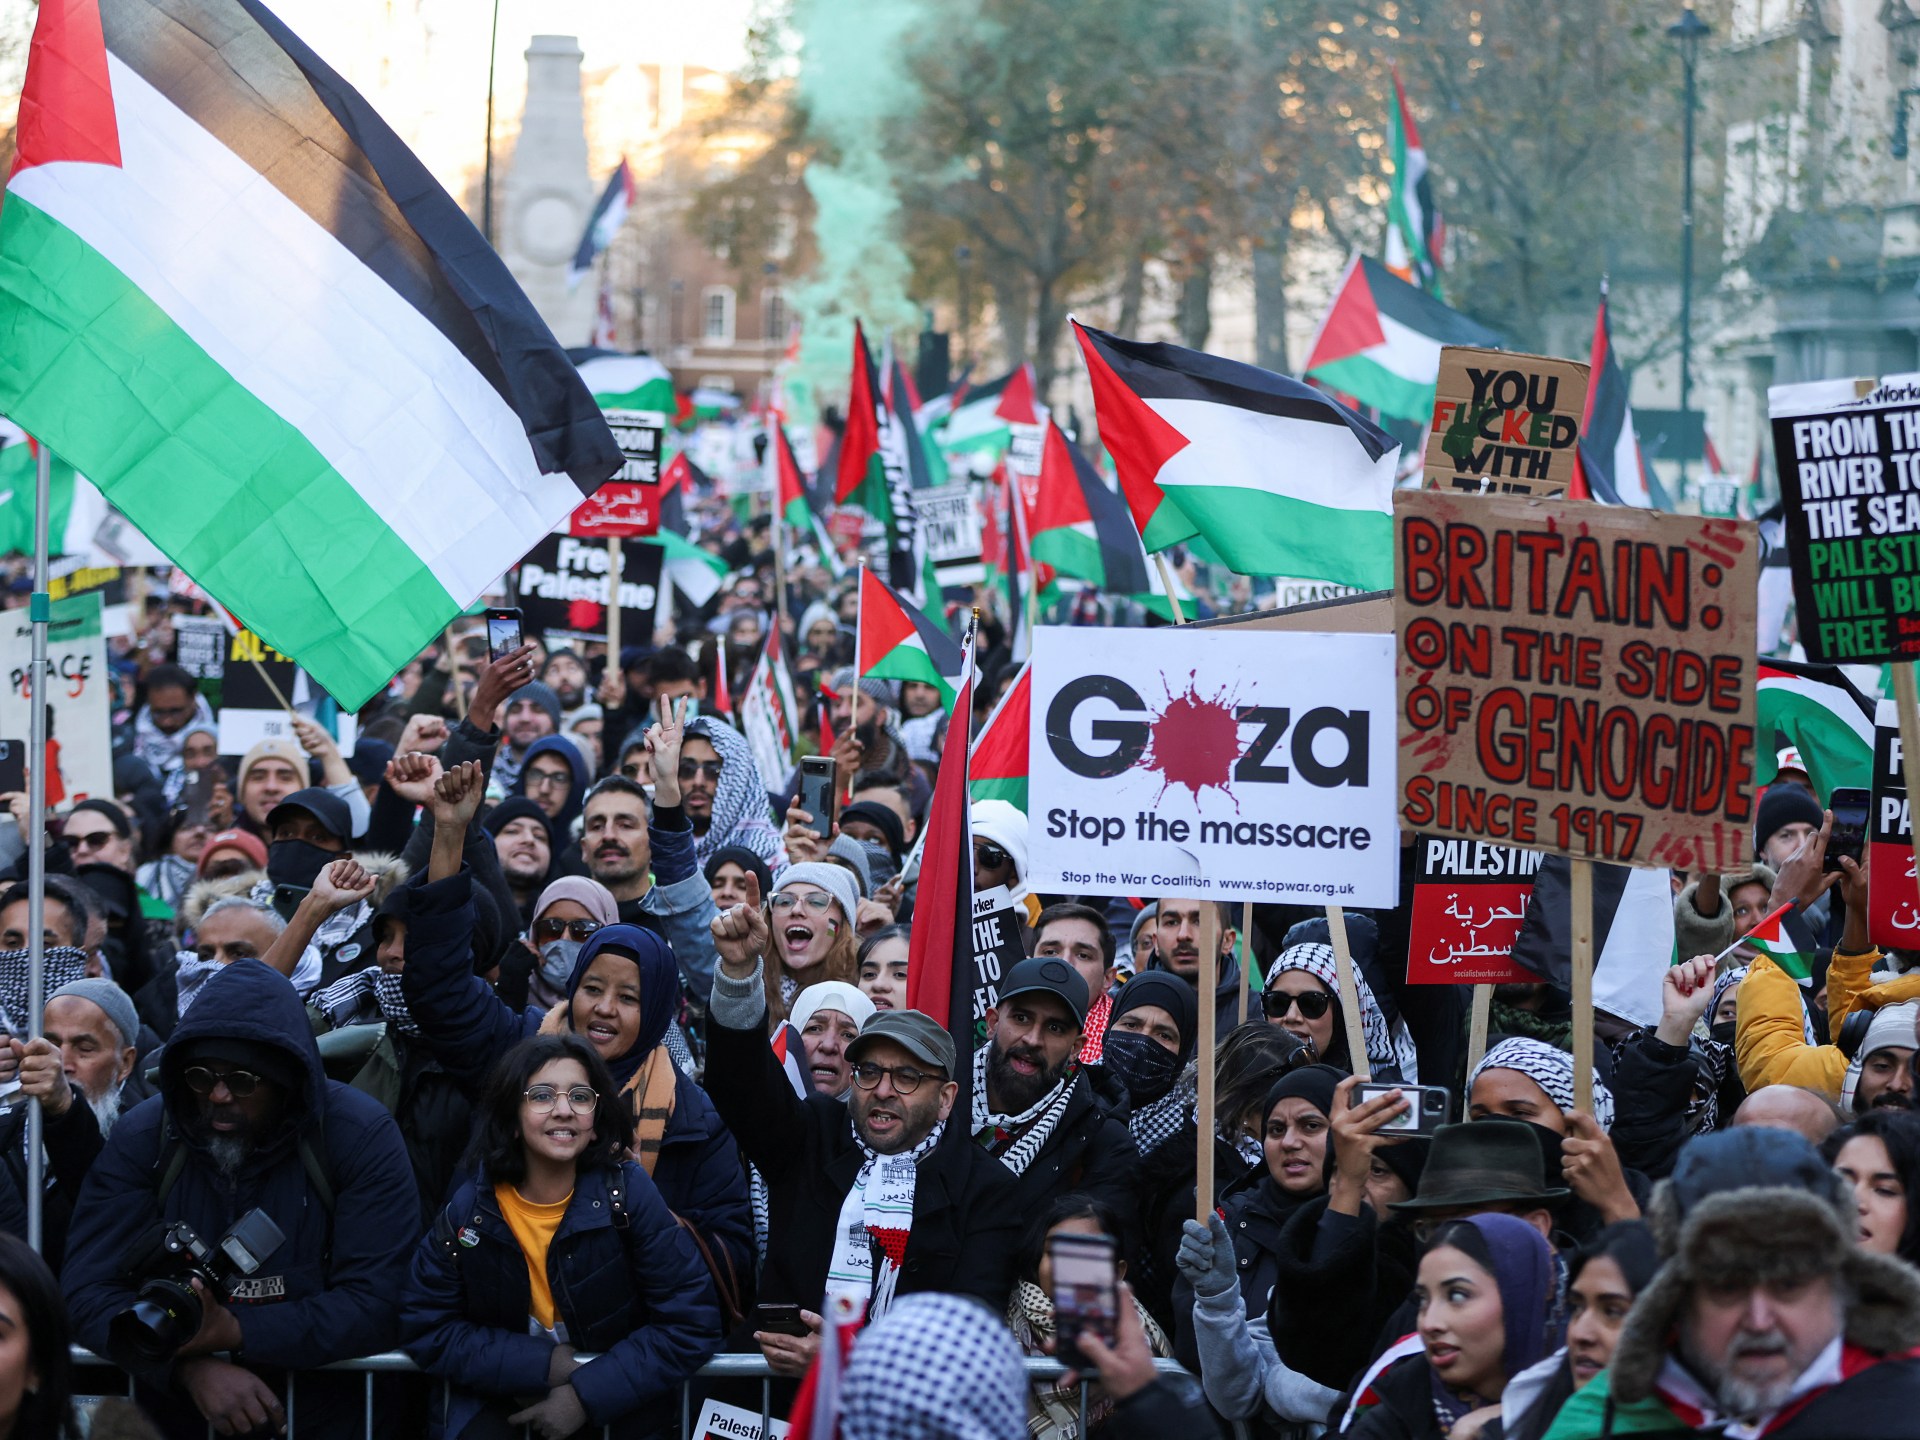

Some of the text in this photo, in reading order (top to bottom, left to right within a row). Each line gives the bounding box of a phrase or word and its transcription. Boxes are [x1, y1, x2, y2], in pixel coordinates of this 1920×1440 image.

[1466, 368, 1559, 413] YOU
[1874, 383, 1920, 403] Work
[1431, 401, 1577, 449] FUCKED
[1793, 411, 1920, 459] FROM TH
[1453, 444, 1552, 480] WITH
[1798, 457, 1885, 499] RIVER
[1802, 493, 1920, 539] THE SEA
[1403, 516, 1725, 632] BRITAIN:
[1808, 534, 1920, 580] PALESTI
[519, 564, 655, 610] Palestne
[1812, 579, 1886, 619] WILL
[1819, 618, 1891, 658] FREE
[1405, 617, 1743, 713] ON THE SIDE
[1405, 684, 1755, 823] OF GENOCIDE
[1047, 808, 1371, 851] Stop the massacre
[1403, 775, 1645, 861] SINCE 1917
[1425, 840, 1545, 875] PALESTIN
[1062, 871, 1355, 896] Stop the War Coalition www.stopwar.org.uk
[974, 897, 995, 914] rker
[974, 951, 1001, 984] TO
[709, 1412, 778, 1440] Palestie
